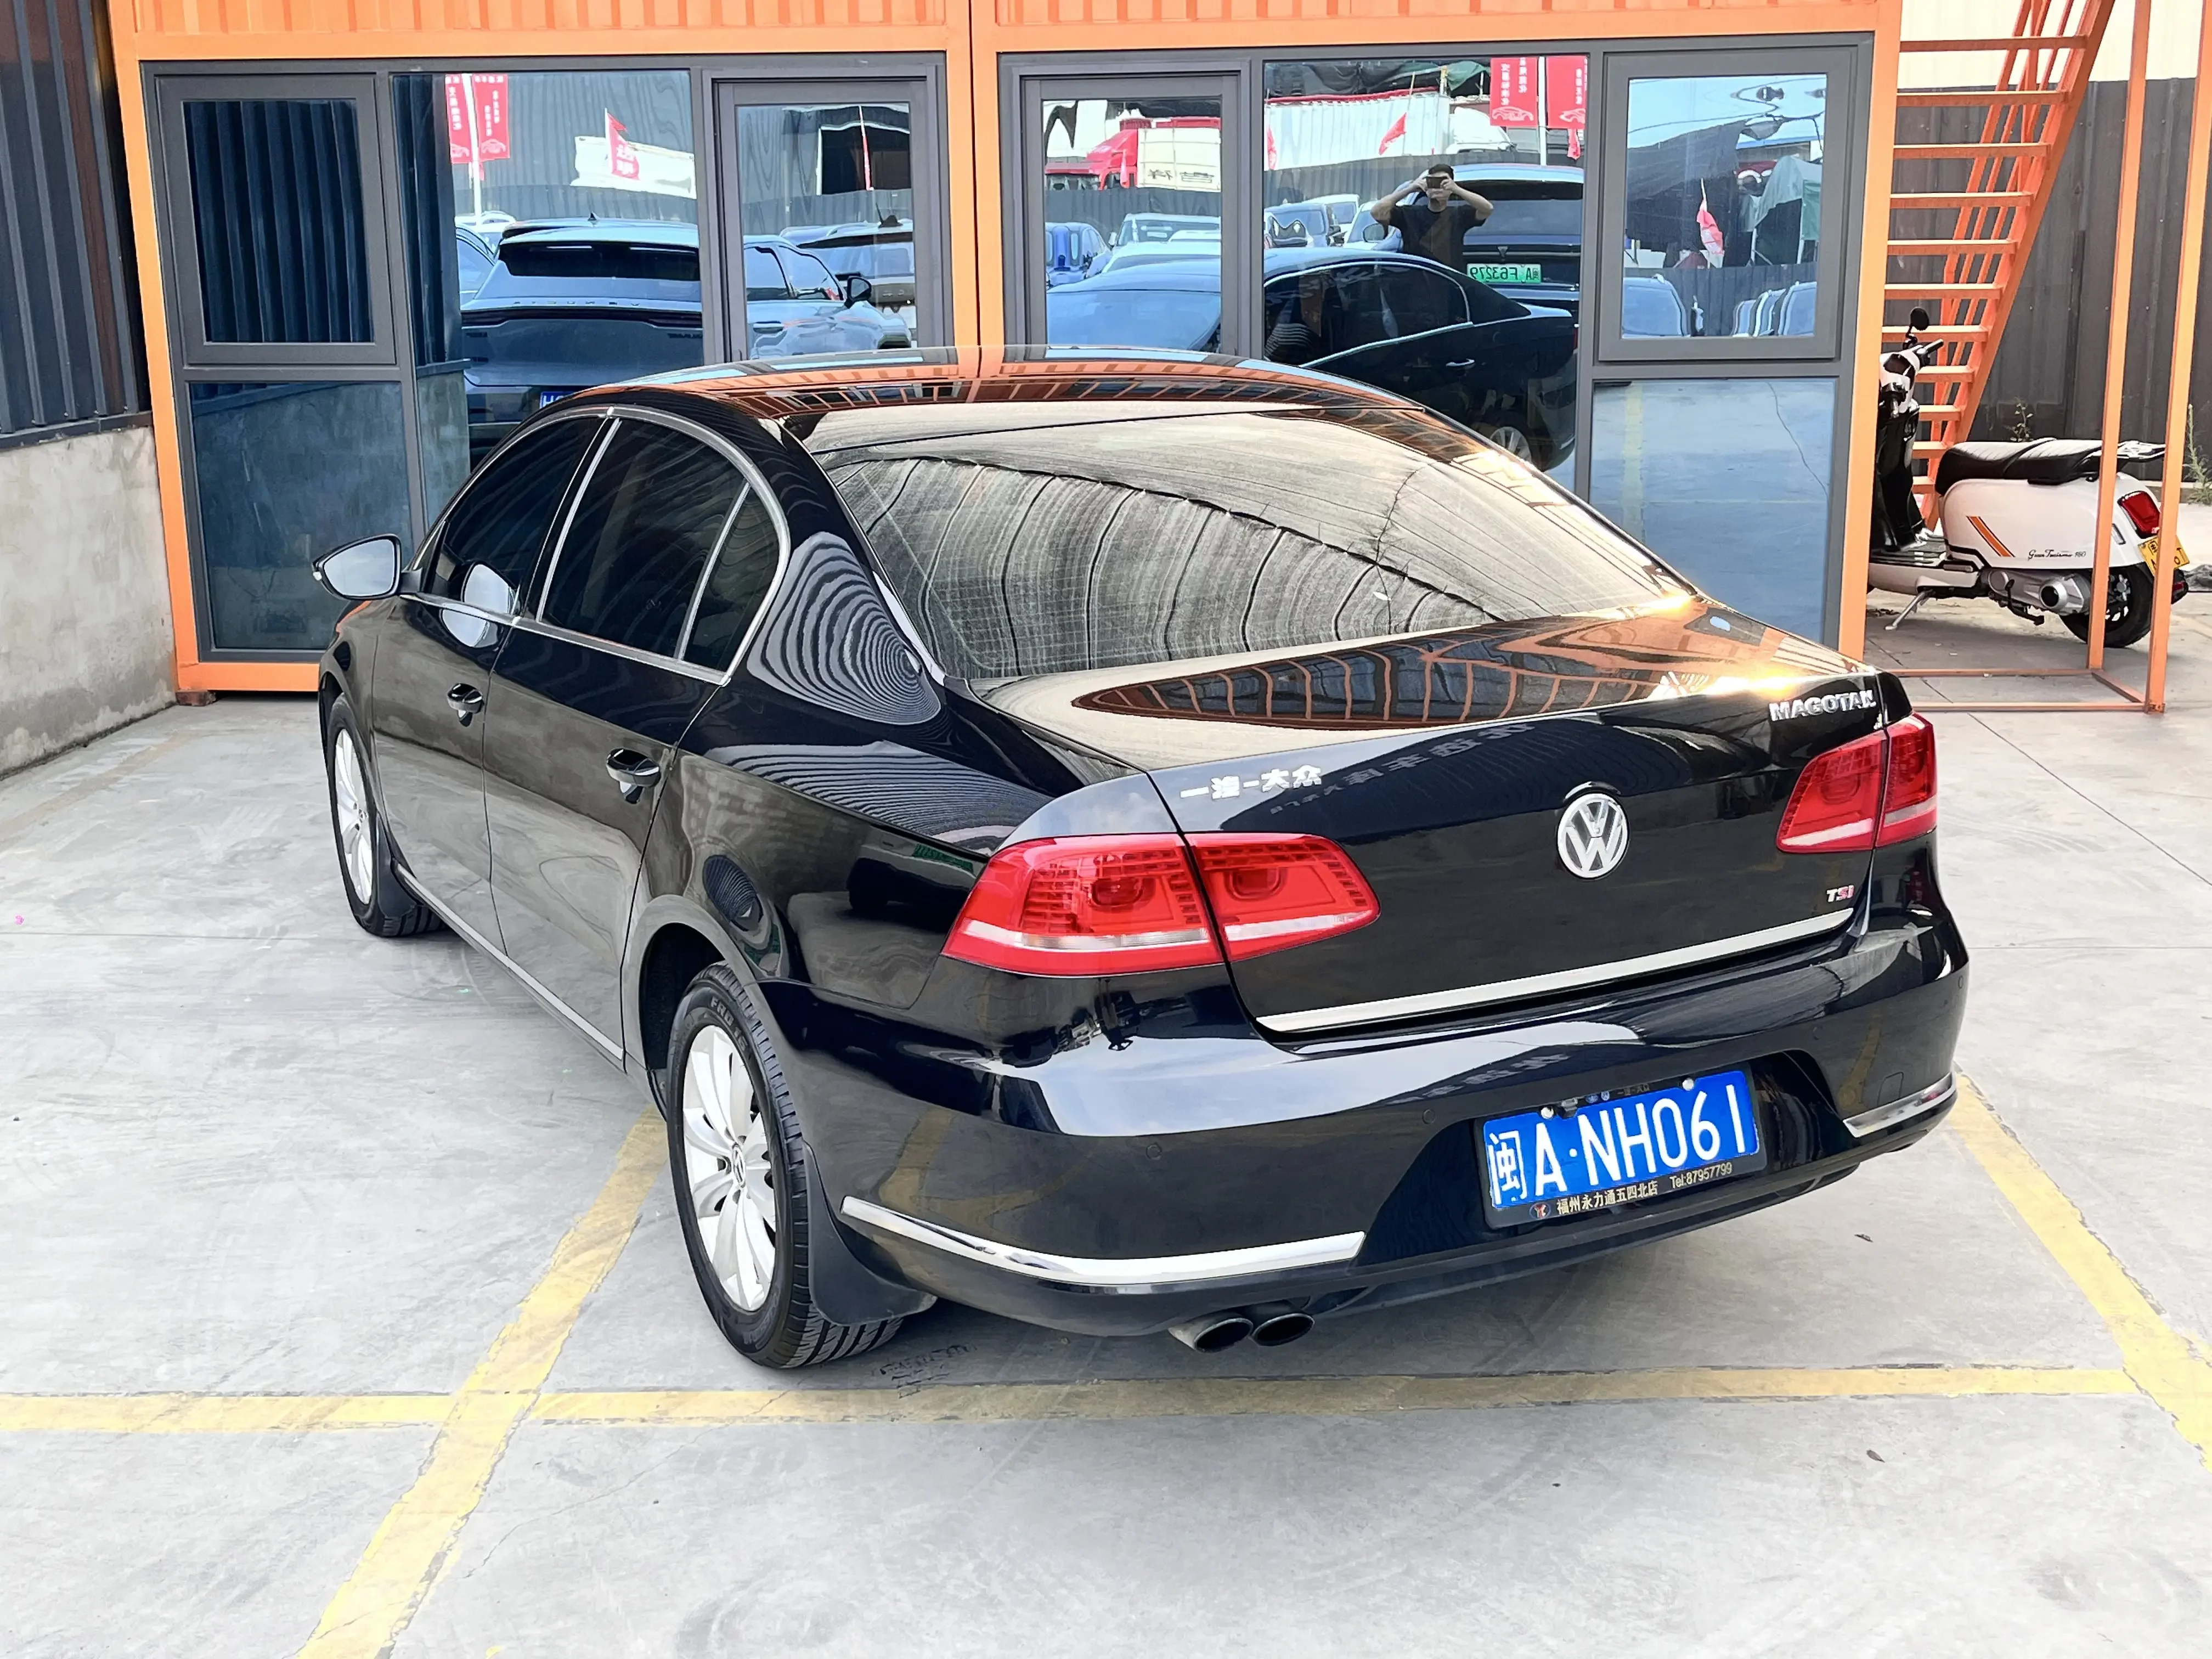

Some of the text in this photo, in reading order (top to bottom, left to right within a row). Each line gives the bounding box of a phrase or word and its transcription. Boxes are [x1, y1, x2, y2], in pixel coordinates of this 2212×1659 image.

[1556, 1180, 1658, 1215] 福州永力通五四北店
[1669, 1161, 1733, 1189] Tel:87957799
